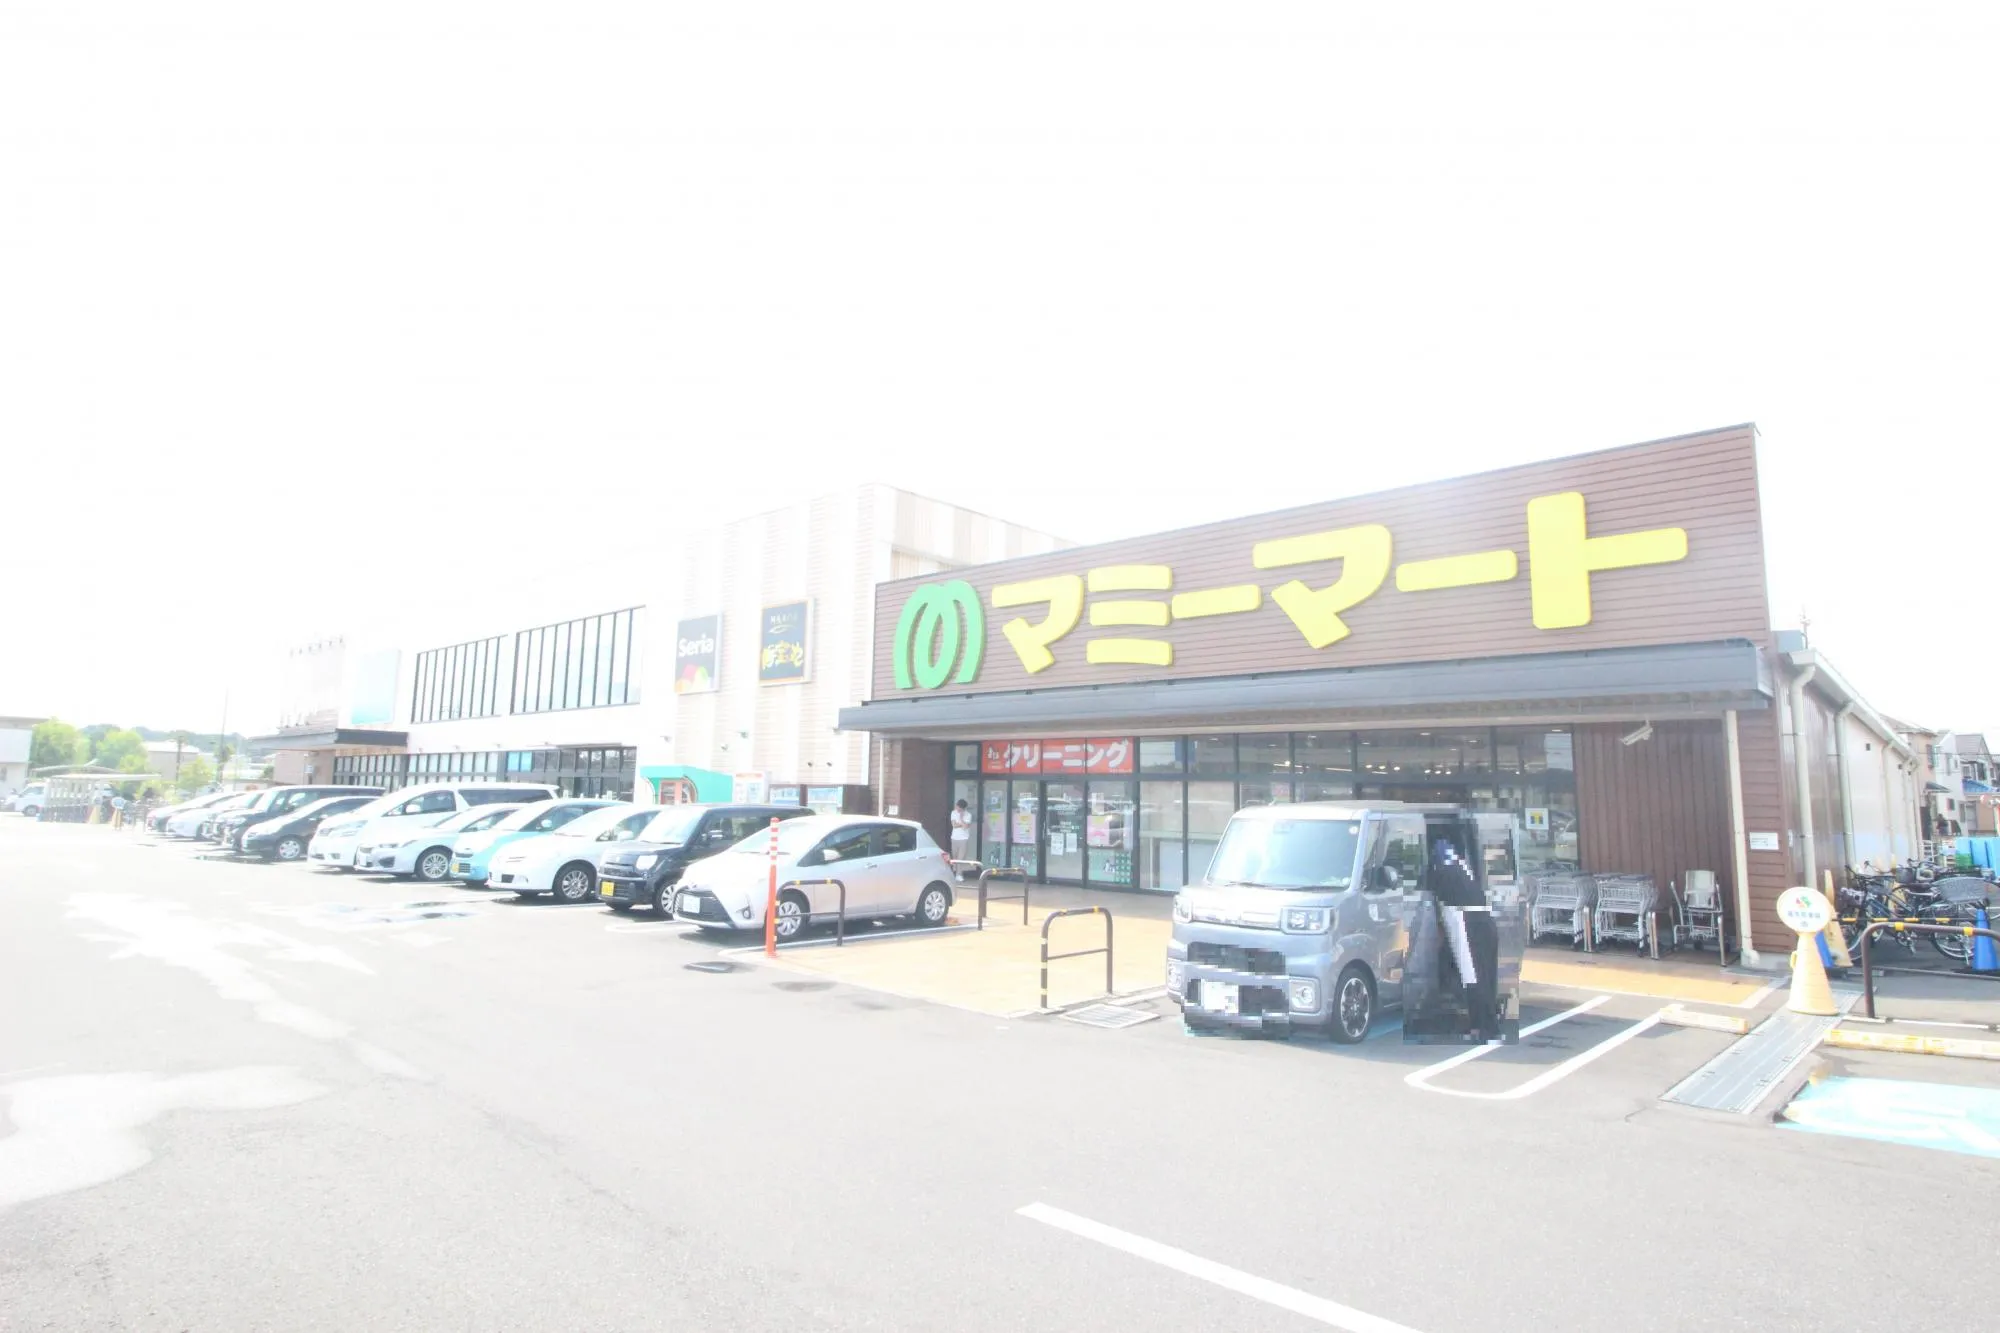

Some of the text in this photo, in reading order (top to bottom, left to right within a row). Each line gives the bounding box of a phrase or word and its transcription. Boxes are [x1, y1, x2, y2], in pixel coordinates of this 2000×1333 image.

[991, 492, 1687, 674] マミーマート
[678, 633, 713, 657] Seria
[1003, 739, 1128, 768] クリーニング
